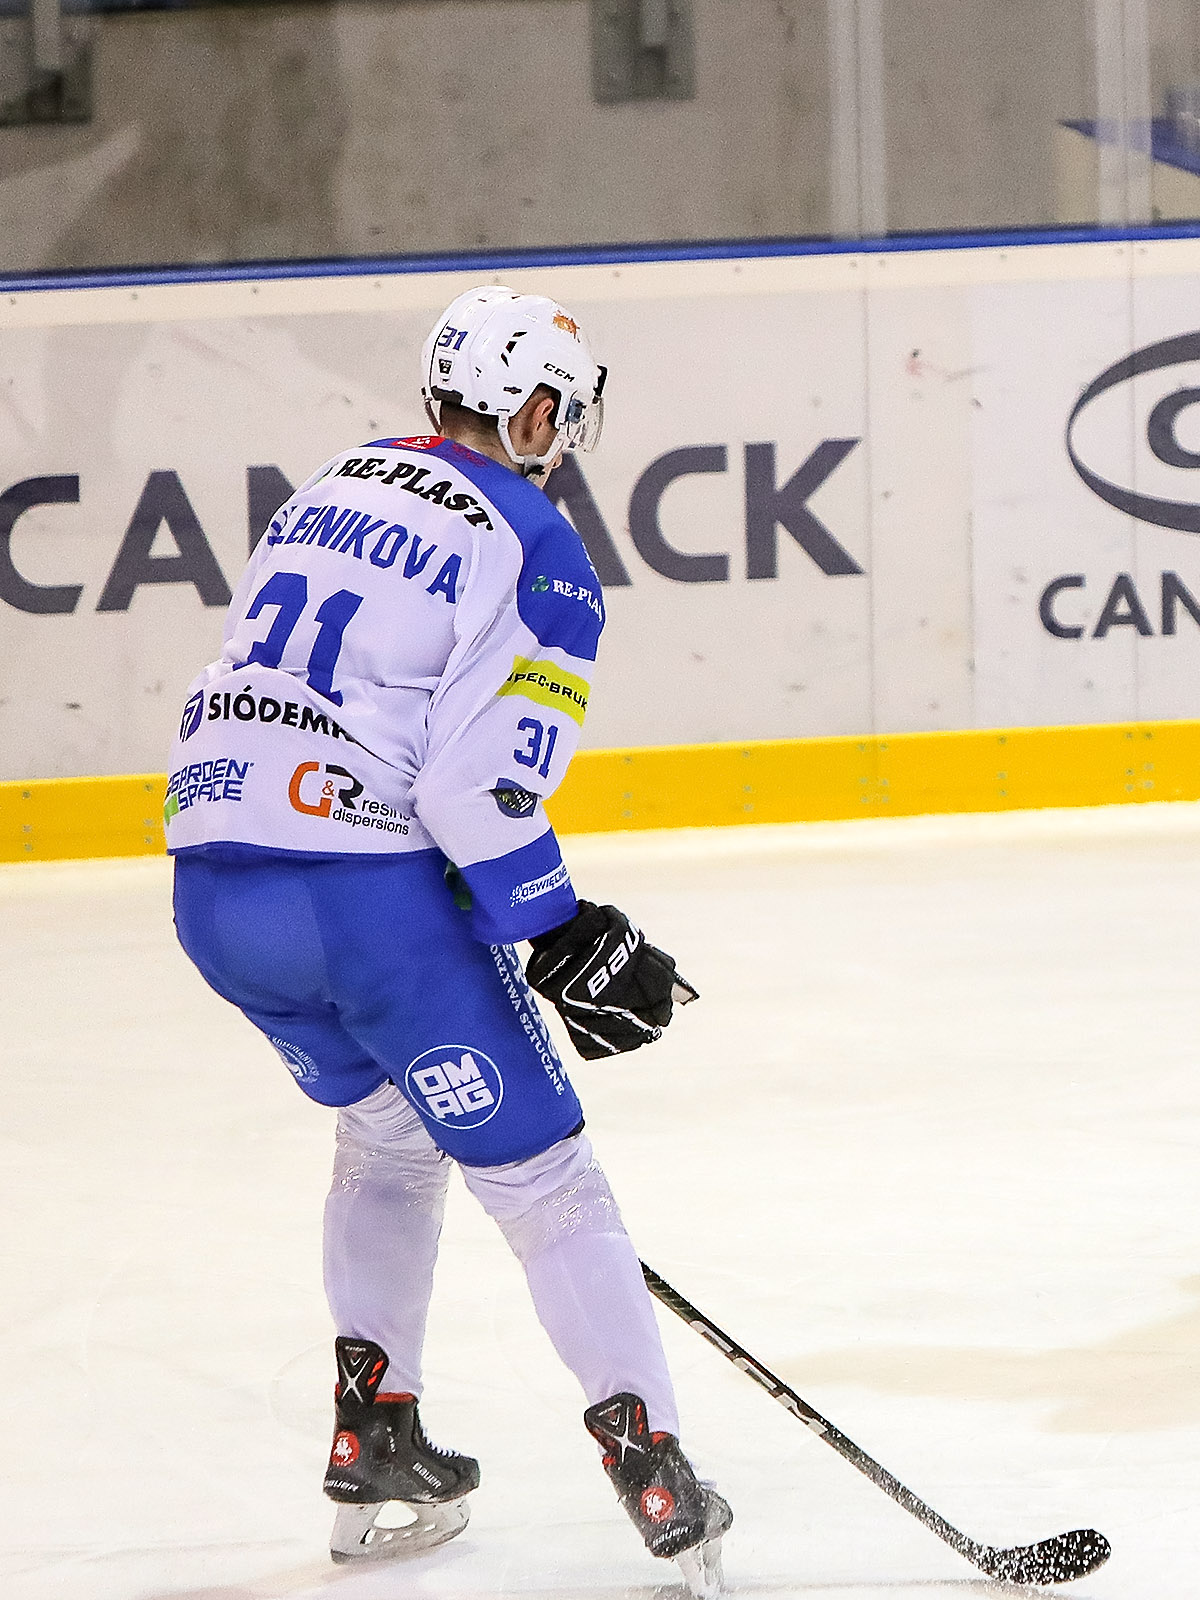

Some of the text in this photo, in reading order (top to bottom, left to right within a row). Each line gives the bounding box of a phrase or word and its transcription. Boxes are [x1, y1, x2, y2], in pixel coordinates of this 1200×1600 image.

[437, 326, 469, 352] 31
[543, 362, 576, 383] CCM
[0, 435, 866, 616] CAACK
[552, 579, 602, 623] RE-PLA
[513, 716, 559, 779] 31
[178, 779, 243, 811] SPACE
[332, 807, 410, 836] dispersions
[518, 1012, 565, 1096] SZTUCZNE
